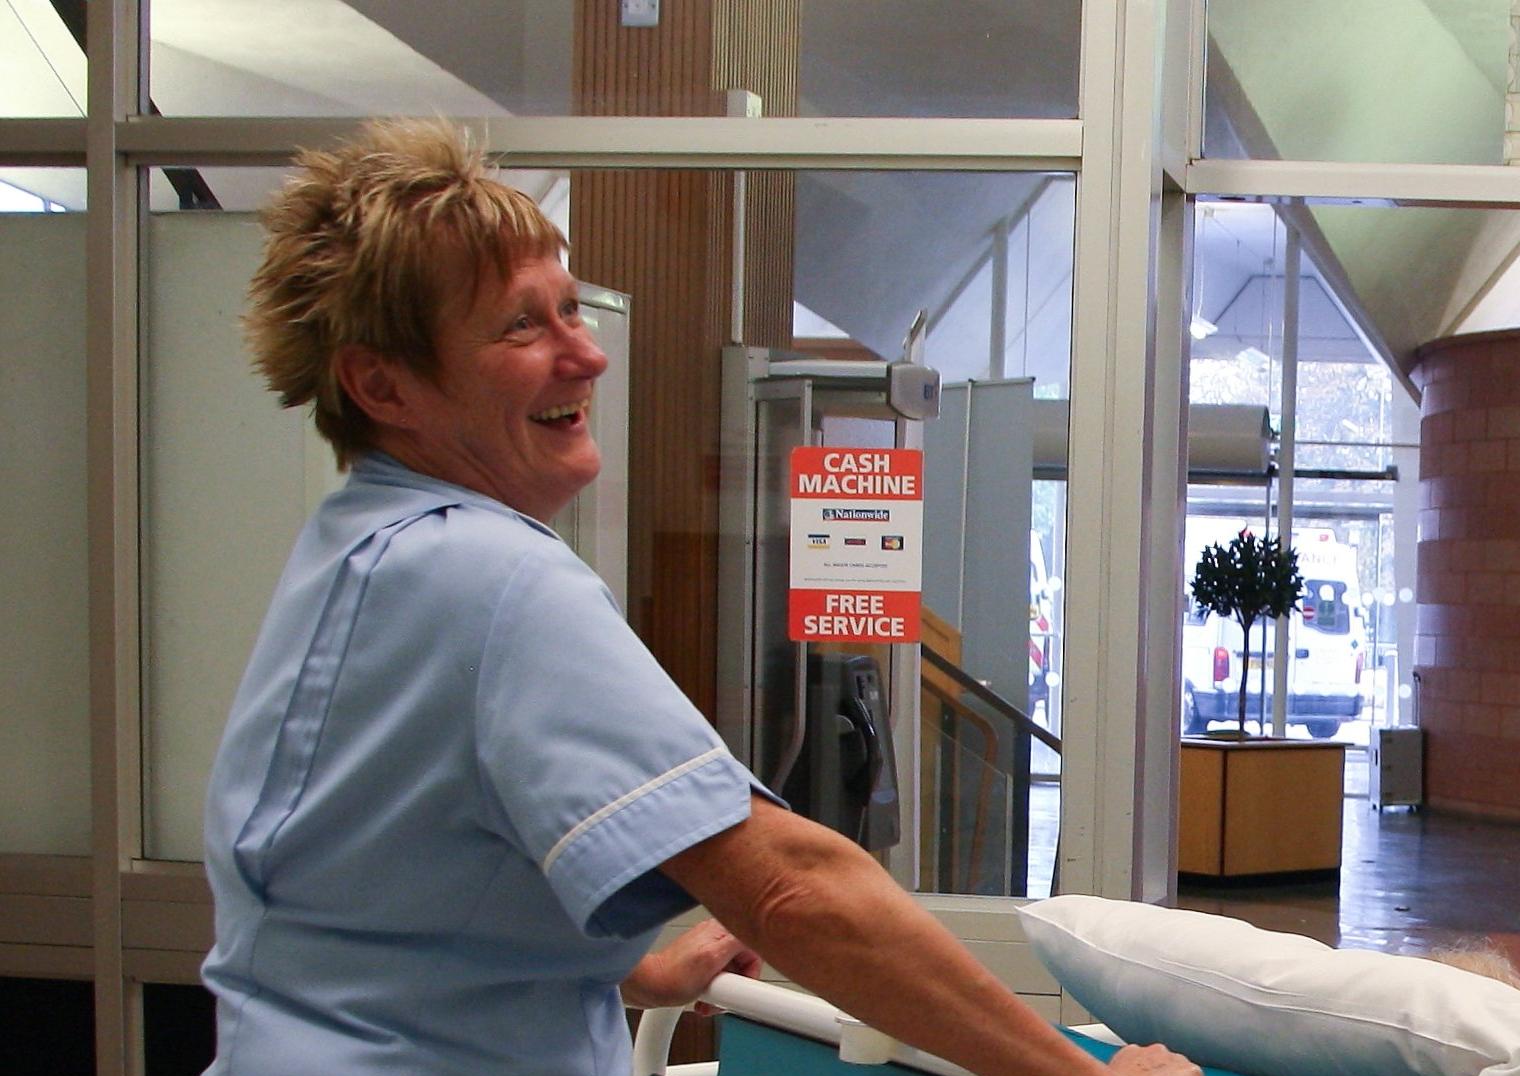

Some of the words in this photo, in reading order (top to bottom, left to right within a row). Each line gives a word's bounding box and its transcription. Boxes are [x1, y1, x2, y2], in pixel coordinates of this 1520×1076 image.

[823, 453, 890, 473] CASH
[798, 474, 916, 495] MACHINE
[835, 508, 889, 520] Nationwide
[826, 594, 885, 615] FREE
[804, 615, 905, 636] SERVICE
